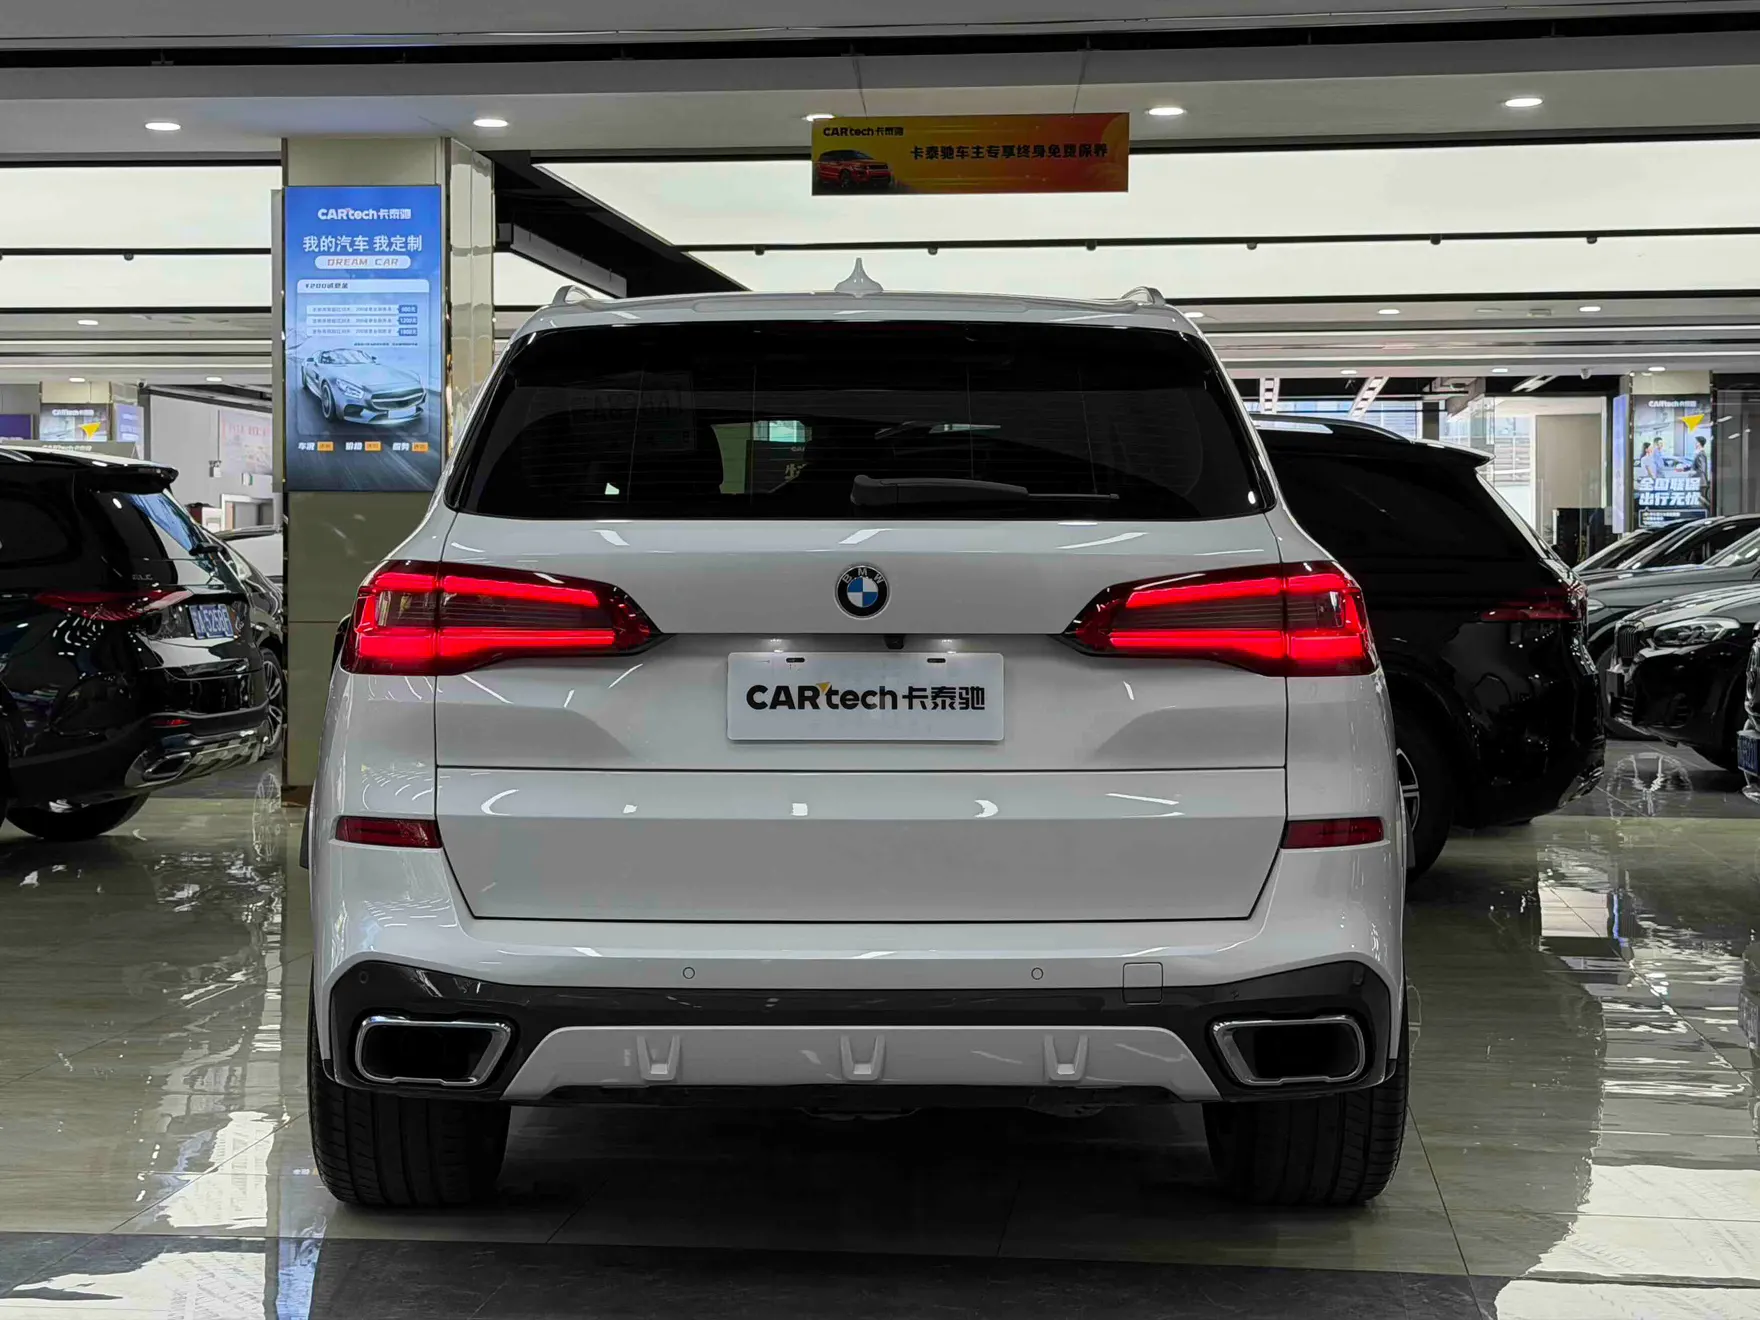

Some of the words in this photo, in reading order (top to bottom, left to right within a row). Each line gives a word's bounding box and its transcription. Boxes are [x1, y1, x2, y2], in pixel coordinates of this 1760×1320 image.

[318, 208, 377, 220] CARtech
[303, 235, 369, 252] 我的汽车
[373, 235, 423, 252] 我定制
[327, 258, 368, 267] DREAM
[375, 258, 399, 267] CAR
[842, 568, 884, 584] BMW
[746, 685, 898, 710] CARtech
[902, 686, 985, 710] 卡泰驰
